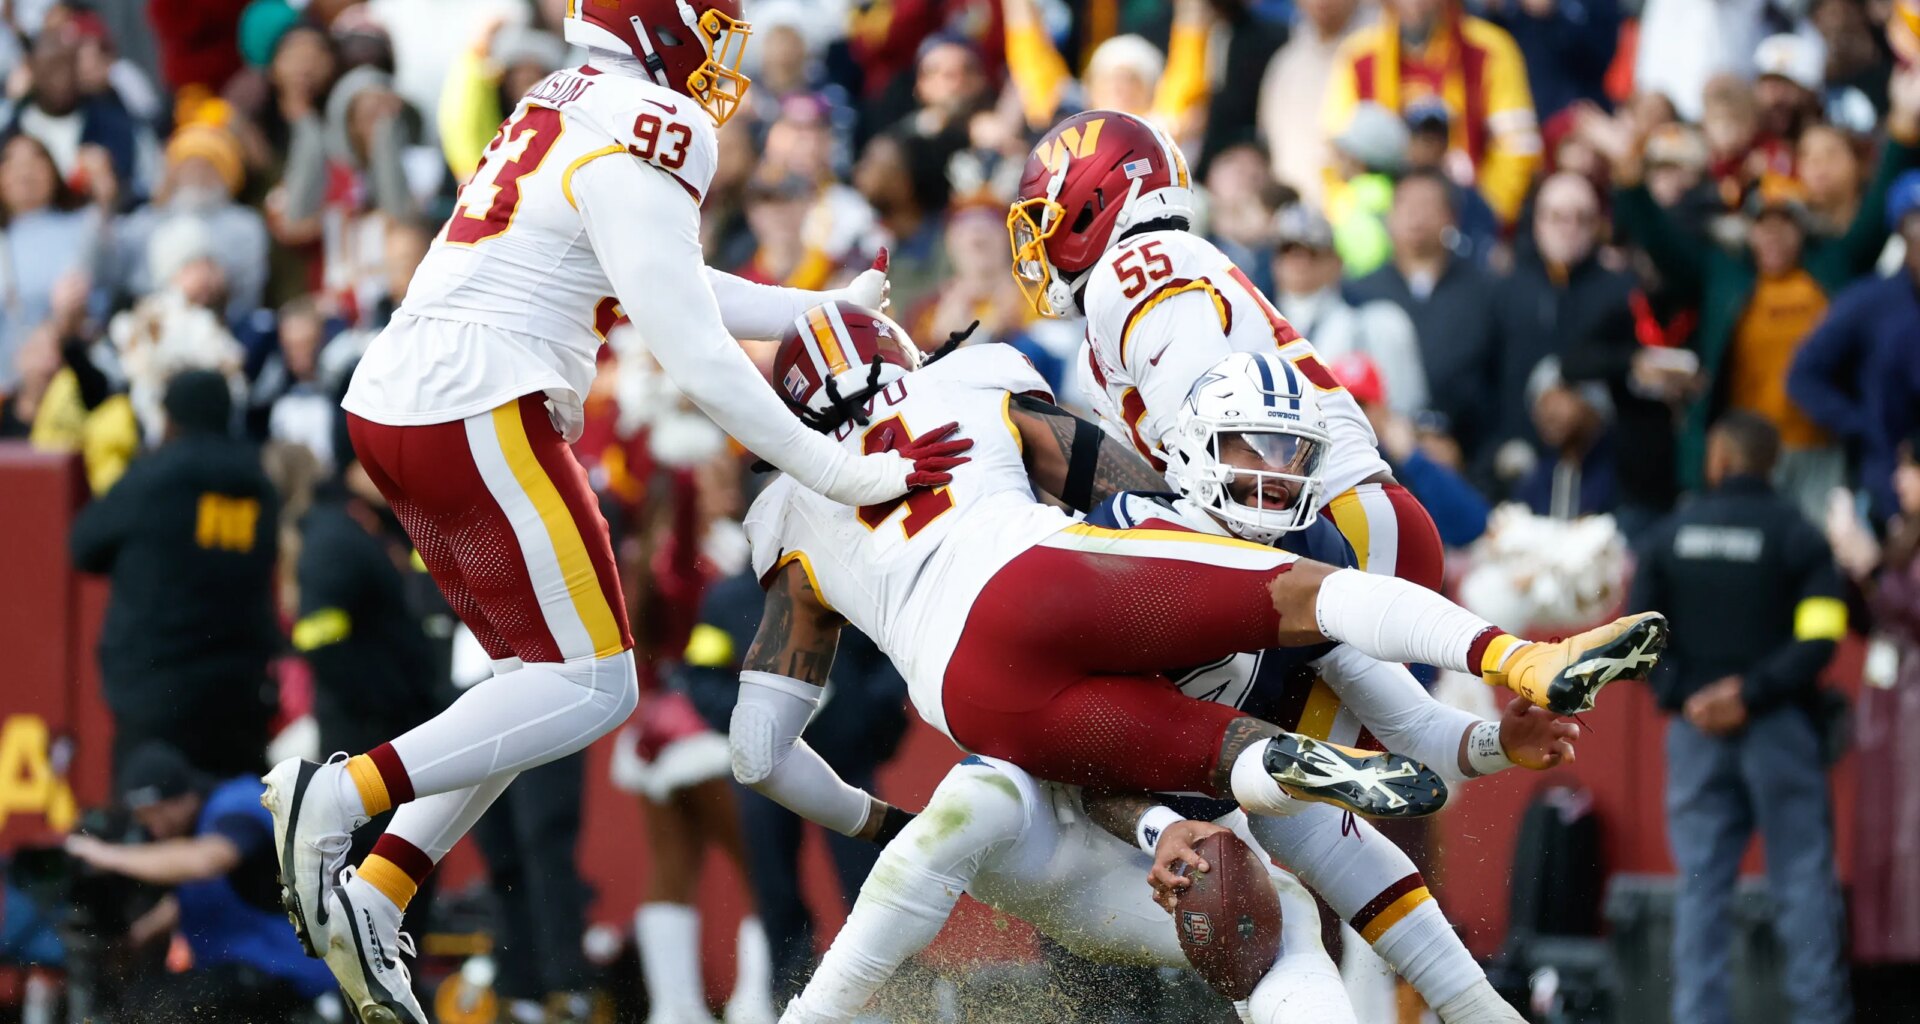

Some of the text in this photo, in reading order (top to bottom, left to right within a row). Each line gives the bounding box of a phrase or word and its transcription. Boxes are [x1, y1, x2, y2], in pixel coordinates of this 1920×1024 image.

[628, 113, 692, 170] 93
[1111, 240, 1173, 300] 55
[1267, 410, 1301, 421] COWBOYS
[1143, 825, 1160, 848] 4
[372, 946, 384, 974] ZOOM
